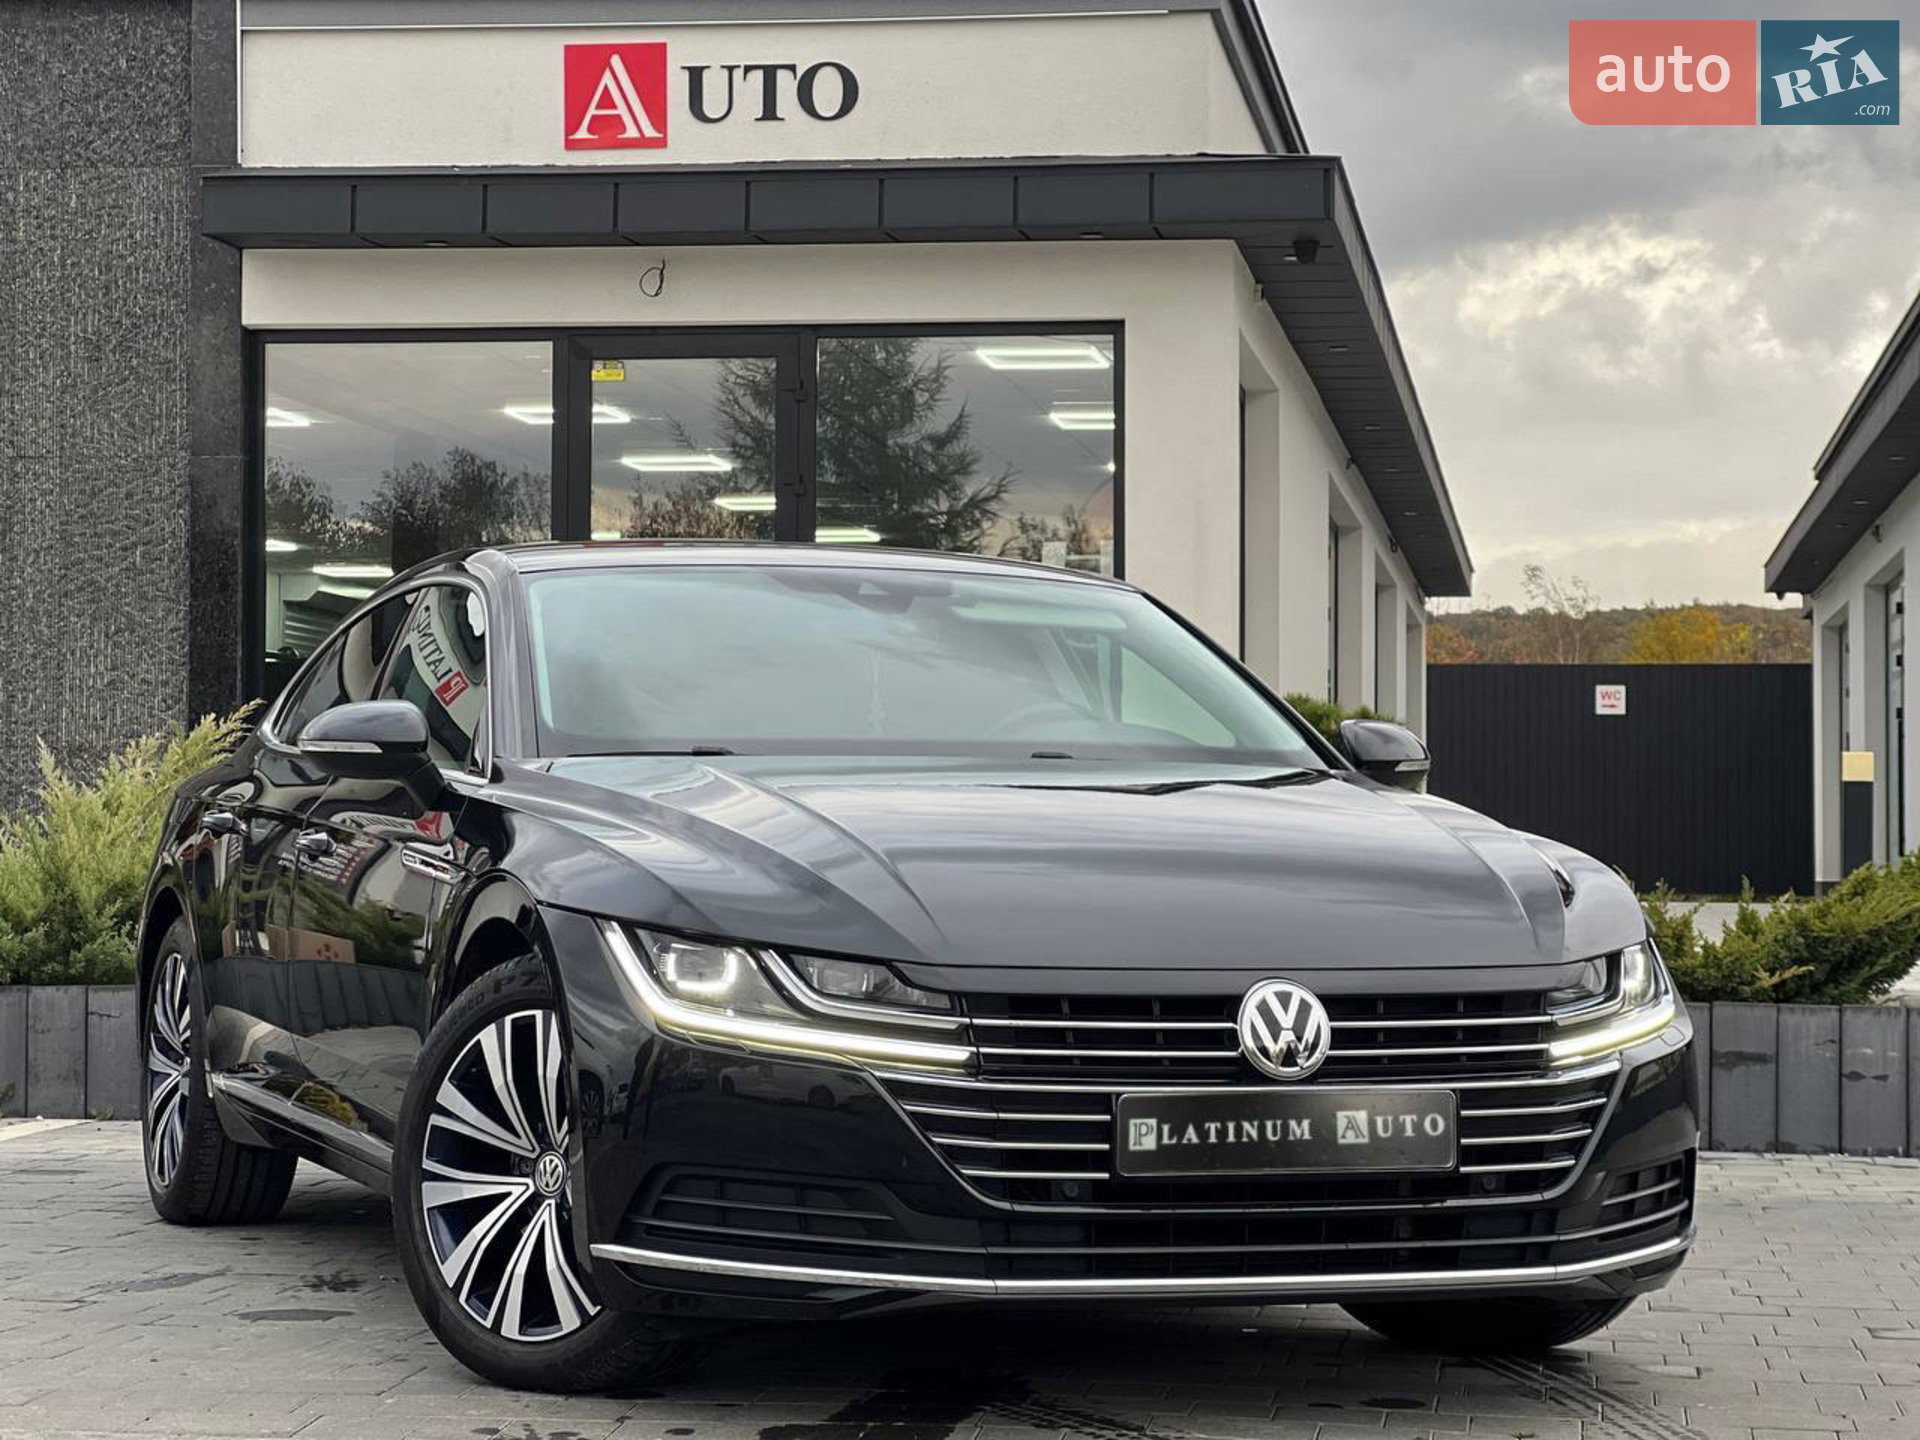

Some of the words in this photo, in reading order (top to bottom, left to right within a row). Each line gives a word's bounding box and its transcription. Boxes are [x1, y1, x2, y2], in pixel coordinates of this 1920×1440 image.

[567, 53, 860, 139] AUTO
[1601, 690, 1621, 701] WC
[1130, 1118, 1313, 1148] PLATINUM
[1338, 1112, 1446, 1142] AUTO
